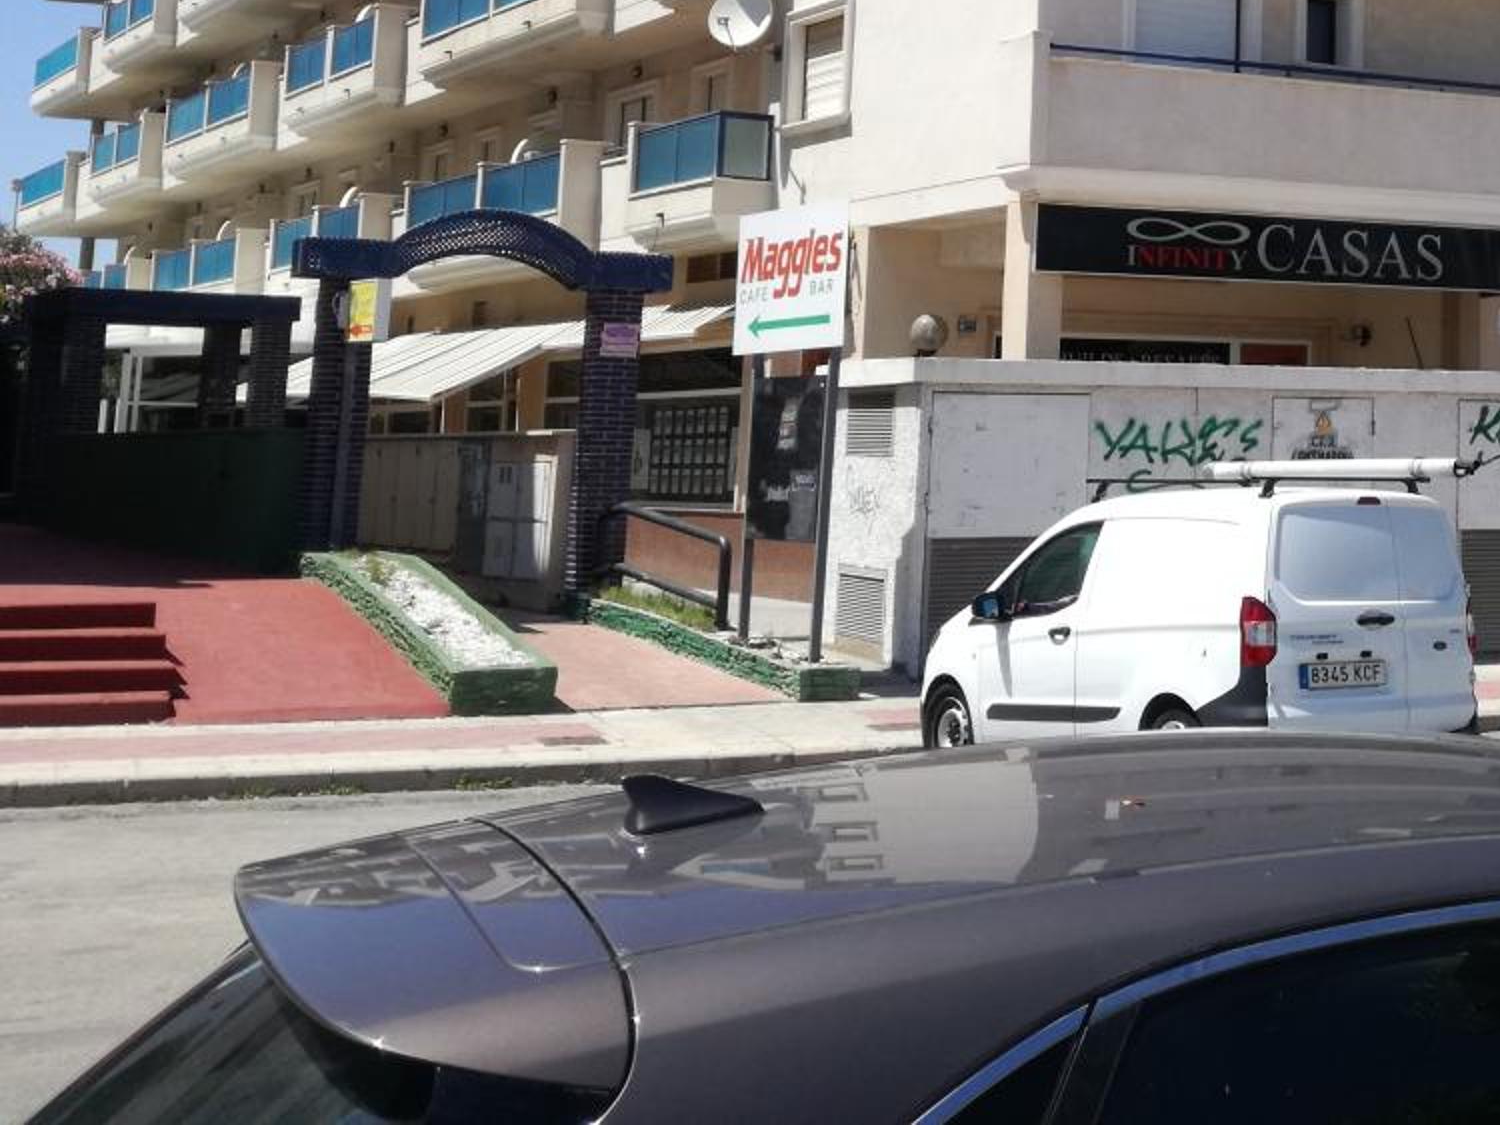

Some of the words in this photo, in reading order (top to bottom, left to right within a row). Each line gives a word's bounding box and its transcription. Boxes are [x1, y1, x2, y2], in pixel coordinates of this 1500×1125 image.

[741, 228, 844, 299] Maggies
[1127, 244, 1247, 271] INFINITY
[1257, 223, 1443, 281] CASAS
[1311, 665, 1349, 684] 8345
[1353, 663, 1381, 682] KCF
